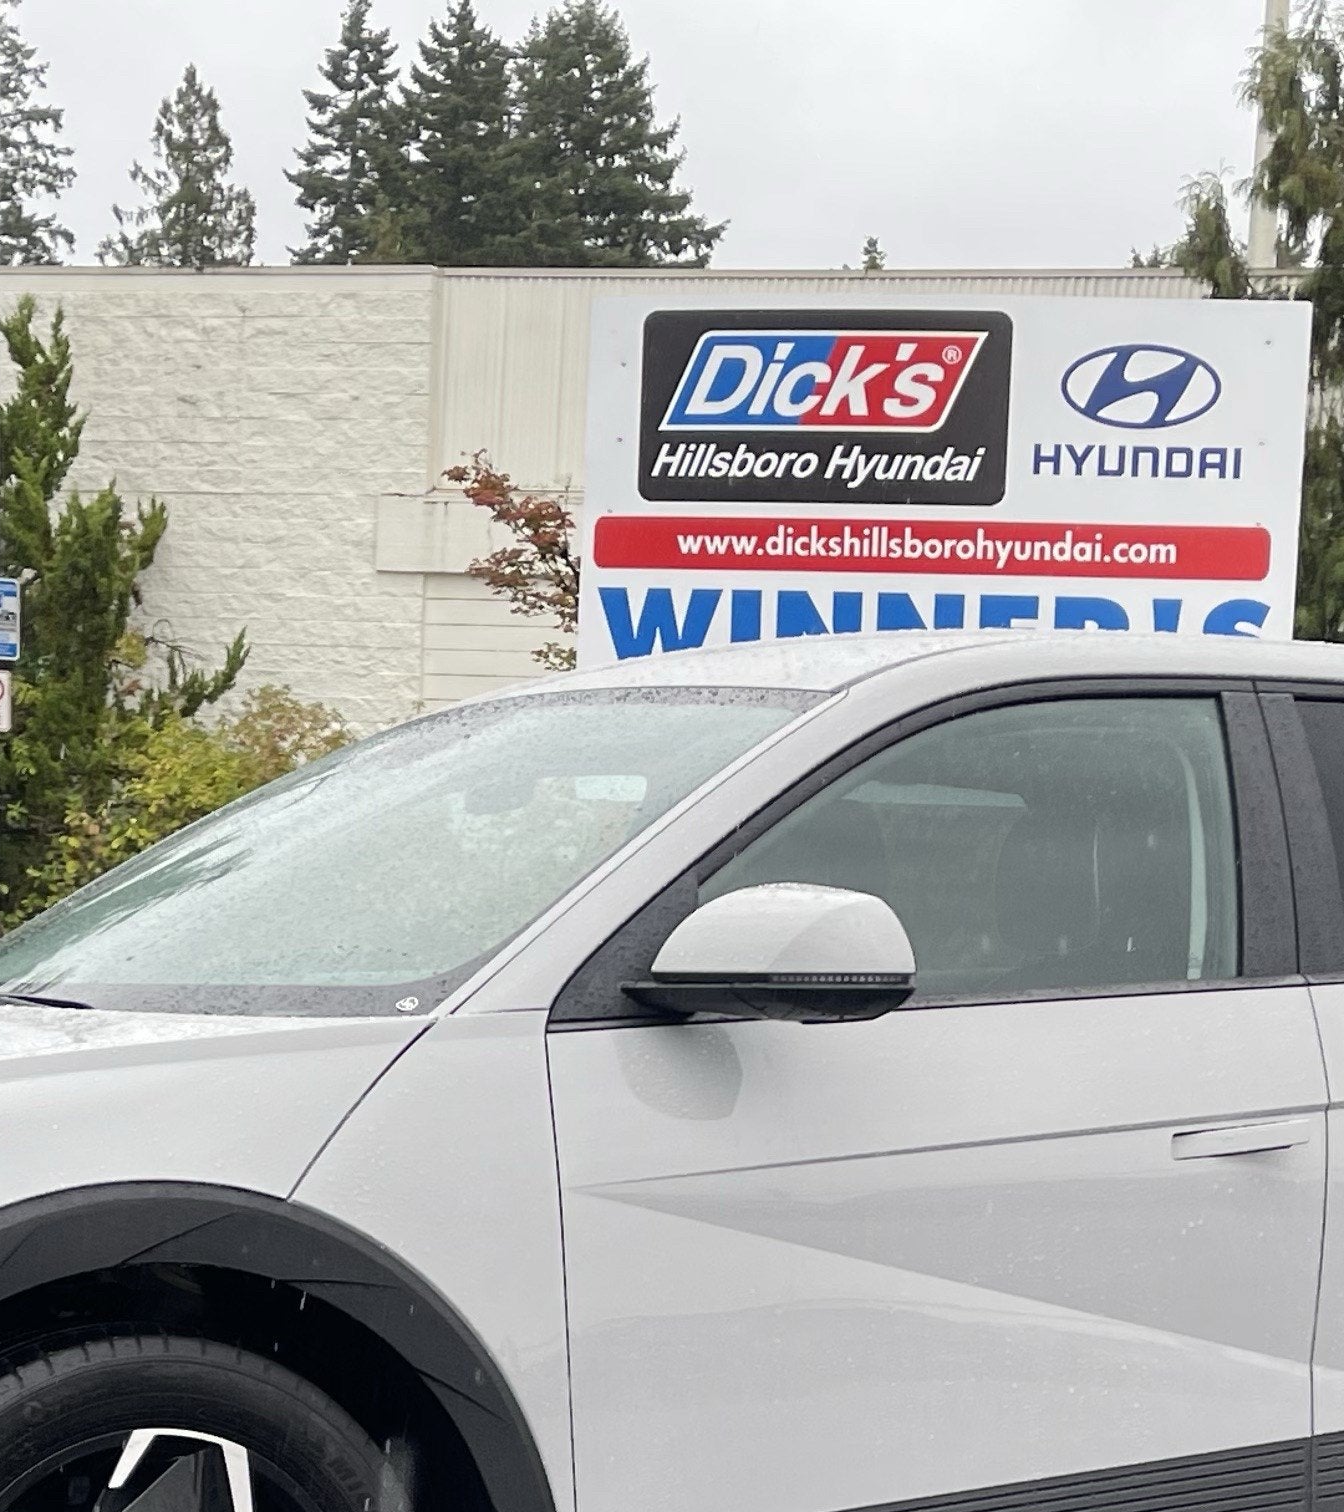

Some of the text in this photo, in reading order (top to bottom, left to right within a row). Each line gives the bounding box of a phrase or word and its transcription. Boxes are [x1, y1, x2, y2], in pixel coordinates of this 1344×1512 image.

[650, 443, 988, 489] Hillsboro Hyundai
[1032, 443, 1242, 480] HYUNDAI
[676, 525, 1178, 569] www.dickshillsborohyundai.com
